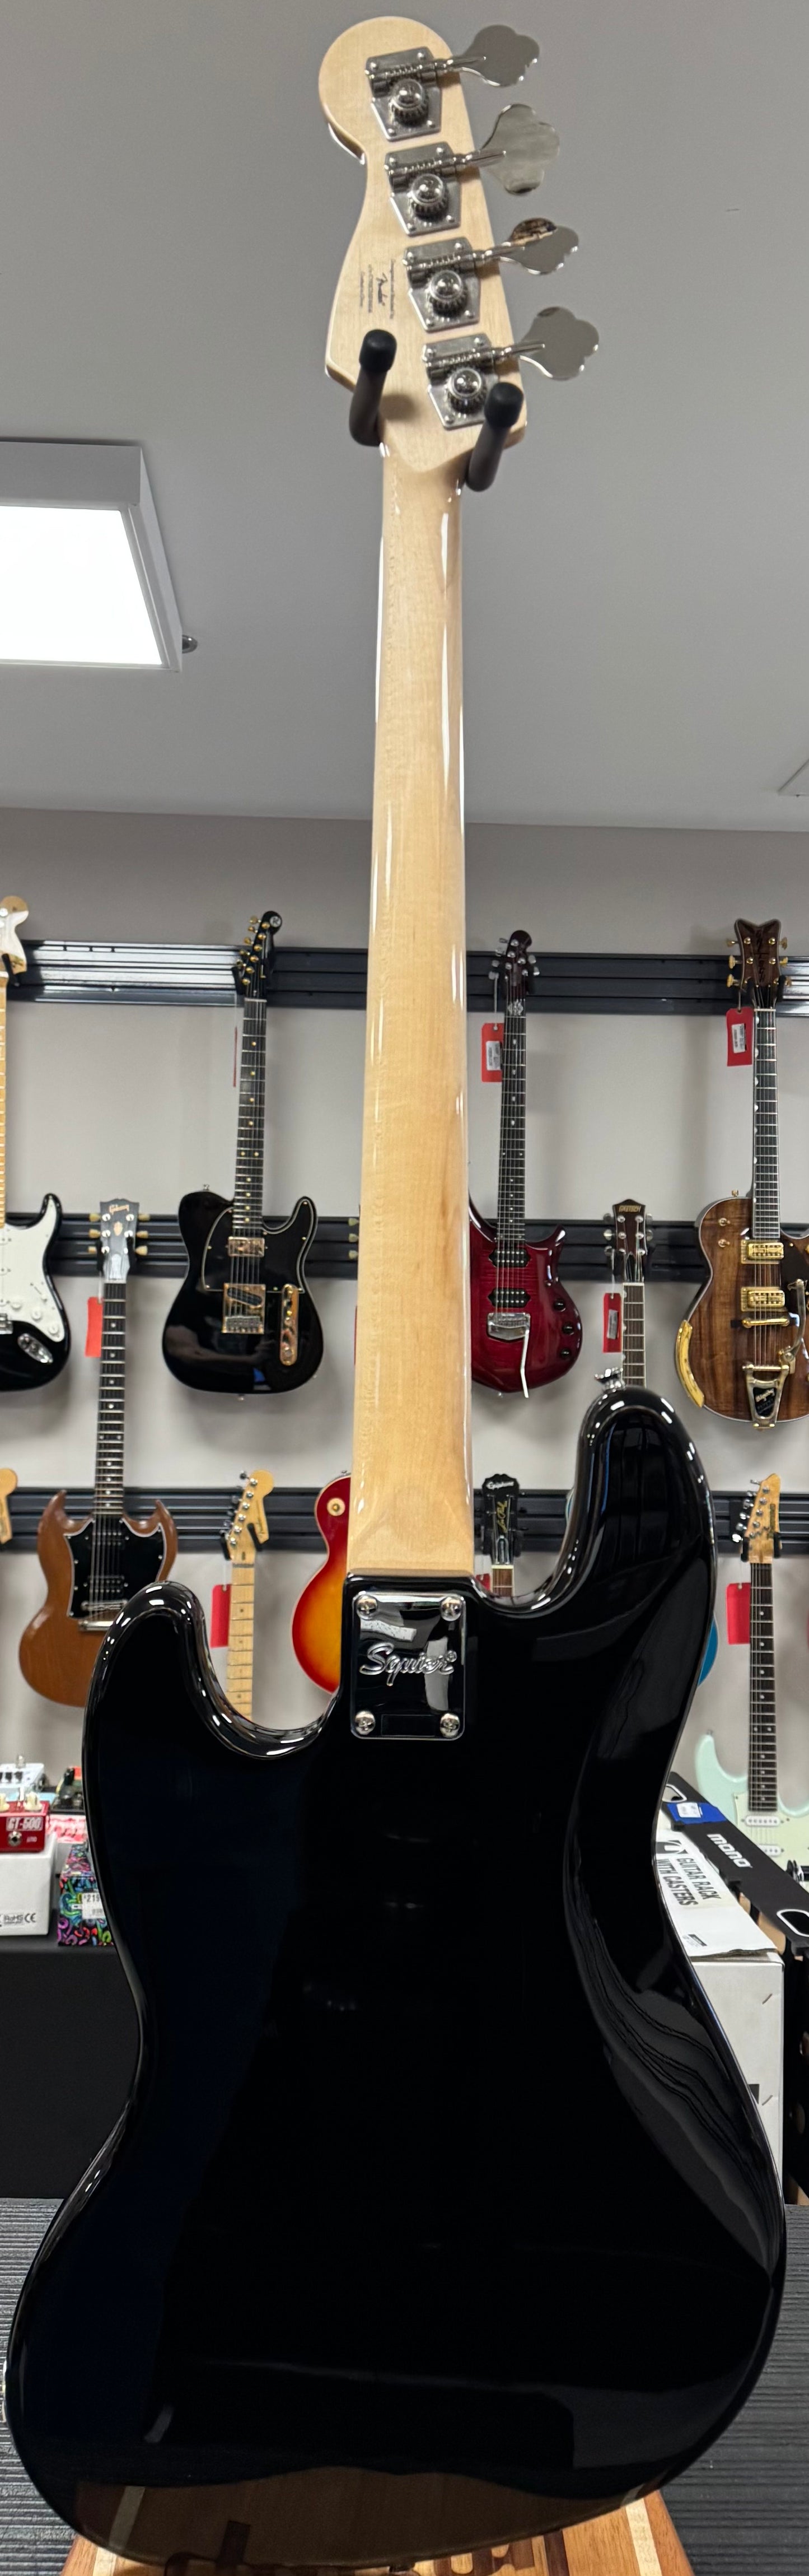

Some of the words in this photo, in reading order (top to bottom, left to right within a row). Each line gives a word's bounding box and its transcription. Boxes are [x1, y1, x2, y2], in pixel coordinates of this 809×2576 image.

[707, 1833, 751, 1867] mono
[662, 1876, 699, 1905] CASTERS
[676, 1857, 707, 1880] GUITAR
[692, 1881, 722, 1899] RACK
